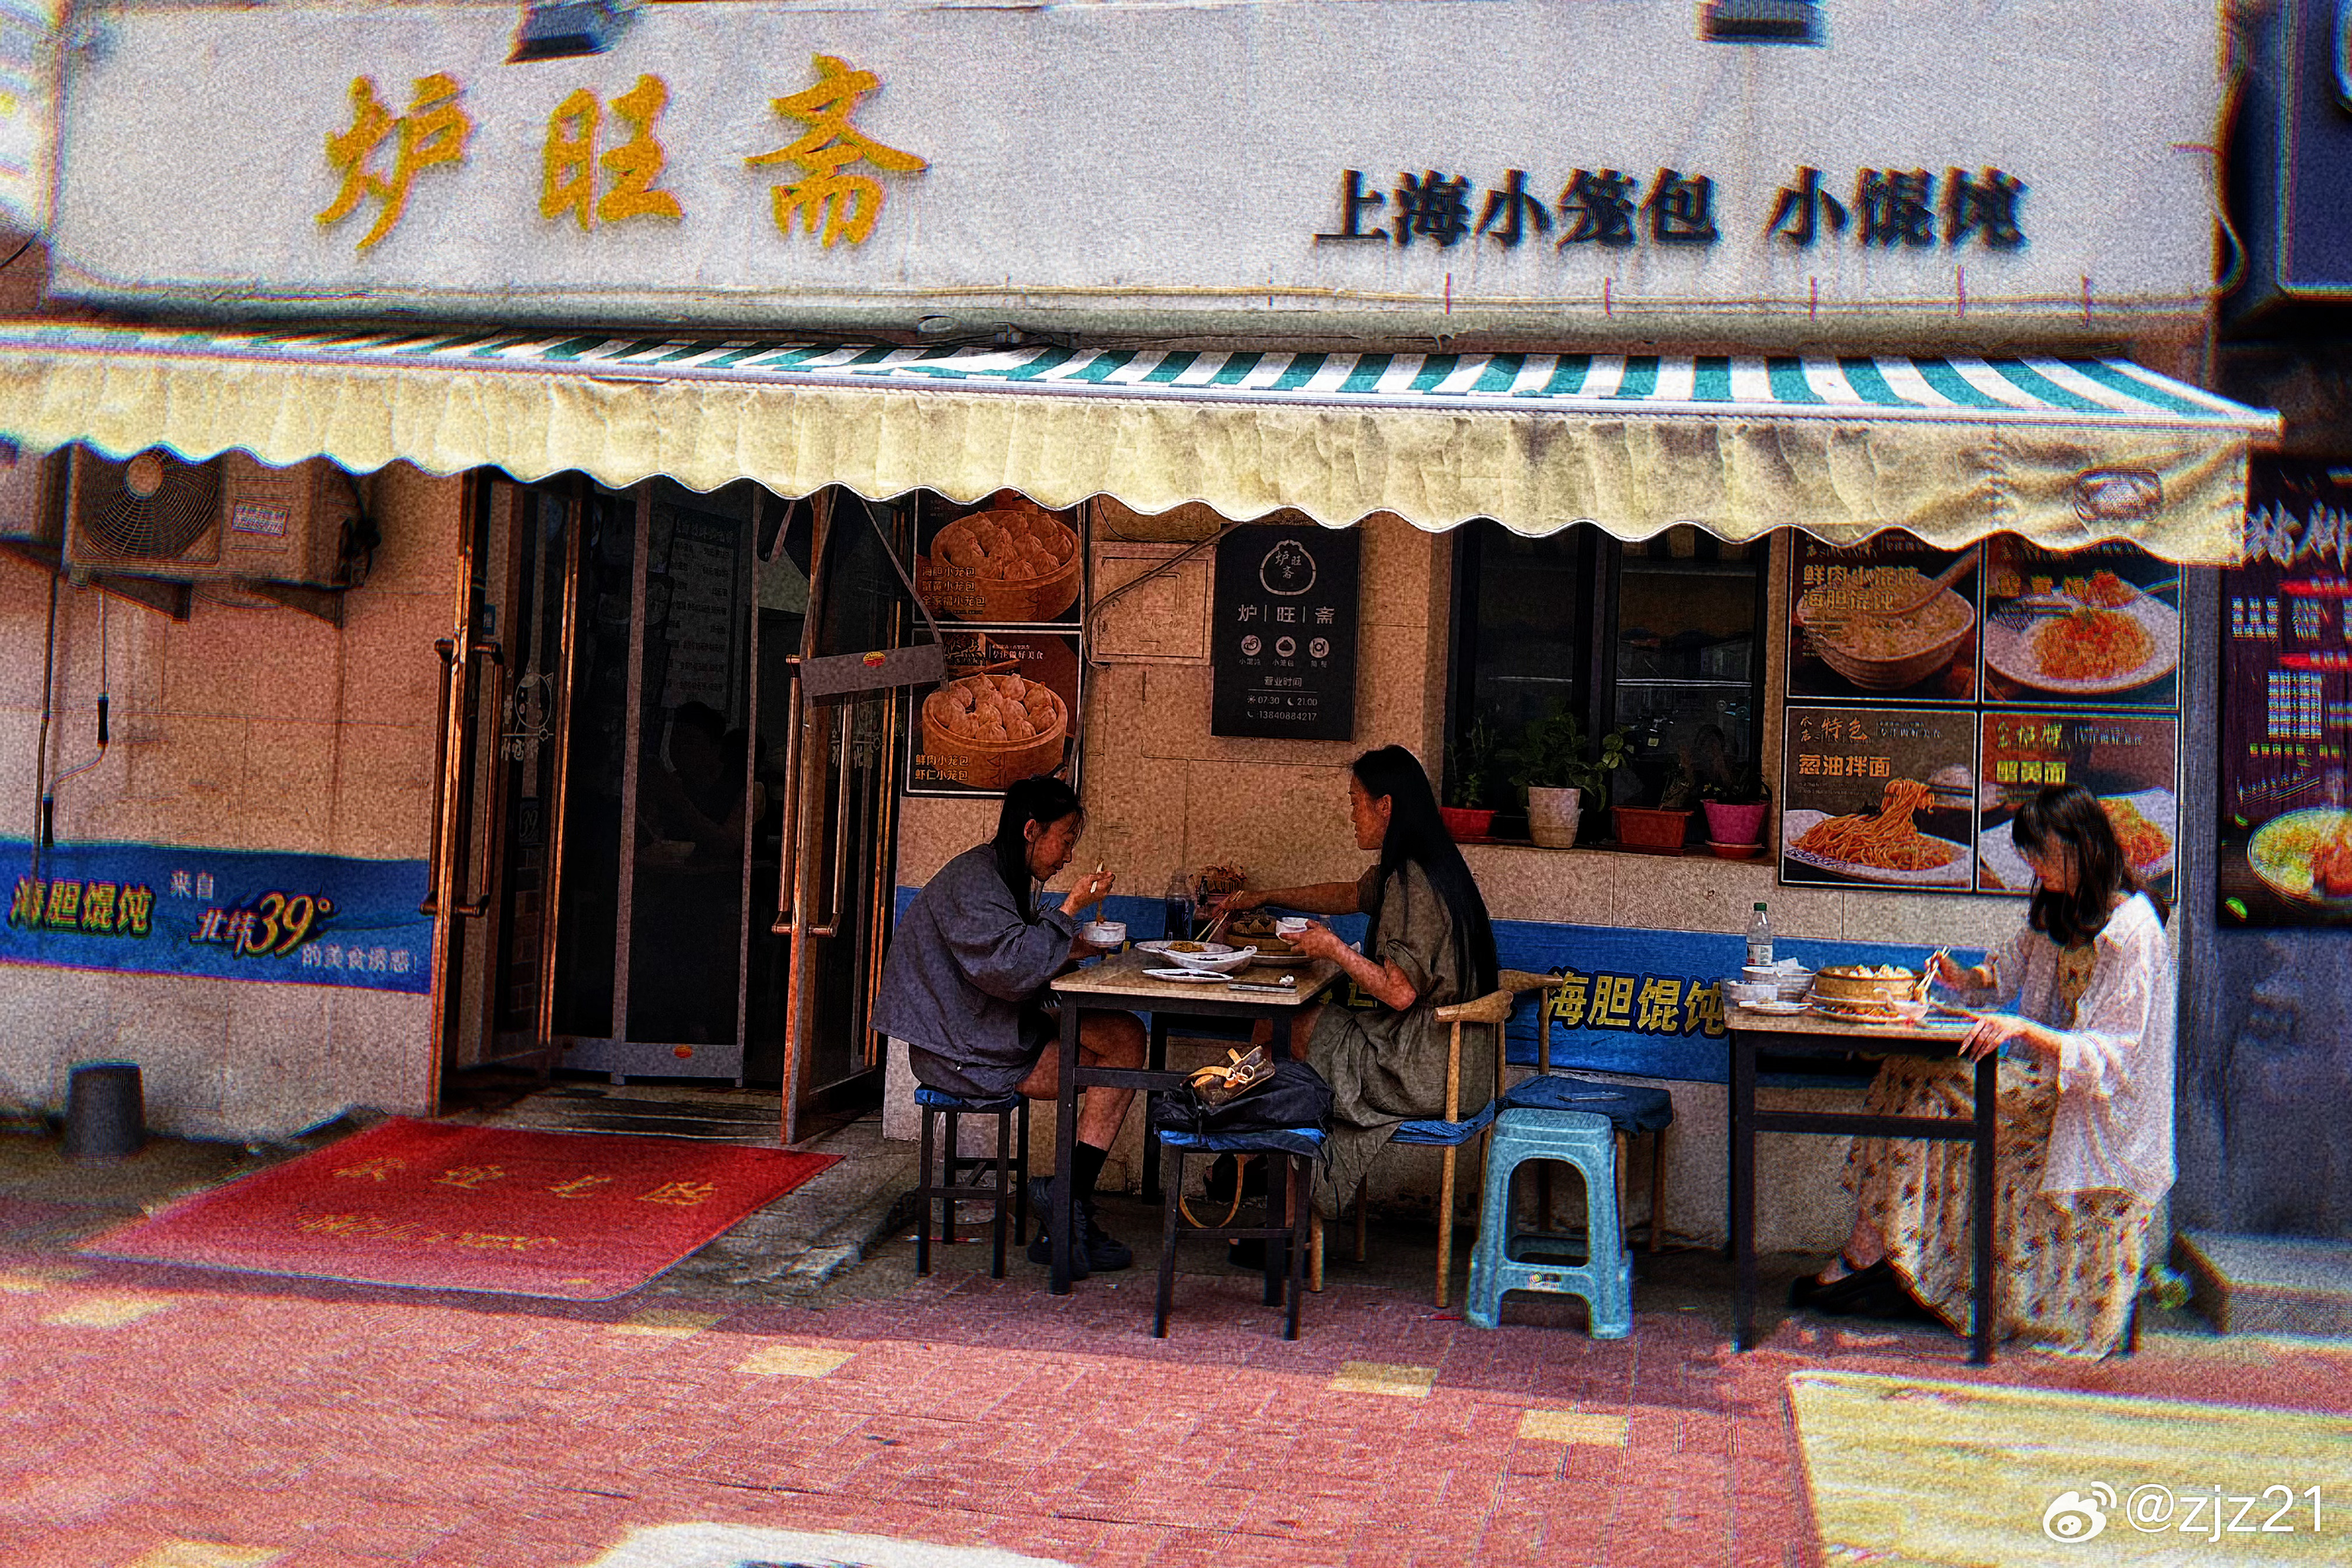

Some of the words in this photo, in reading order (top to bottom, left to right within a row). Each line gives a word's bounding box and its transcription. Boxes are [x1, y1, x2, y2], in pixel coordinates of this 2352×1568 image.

[314, 52, 930, 249] 炉旺斋
[1314, 166, 1720, 250] 上海小笼包
[922, 566, 975, 577] 海胆小笼包
[1803, 565, 1919, 587] 鲜肉小馄饨
[922, 581, 975, 592] 蟹黄小笼包
[922, 595, 985, 607] 全家福小笼包
[1802, 589, 1895, 610] 海胆馄饨
[1264, 676, 1302, 687] 营业时间
[1259, 710, 1317, 721] 13840884217
[915, 755, 969, 767] 鲜肉小笼包
[1799, 754, 1891, 777] 葱油拌面
[915, 769, 968, 782] 虾仁小笼包
[170, 870, 214, 900] 来自
[1549, 971, 1724, 1035] 海胆馄饨
